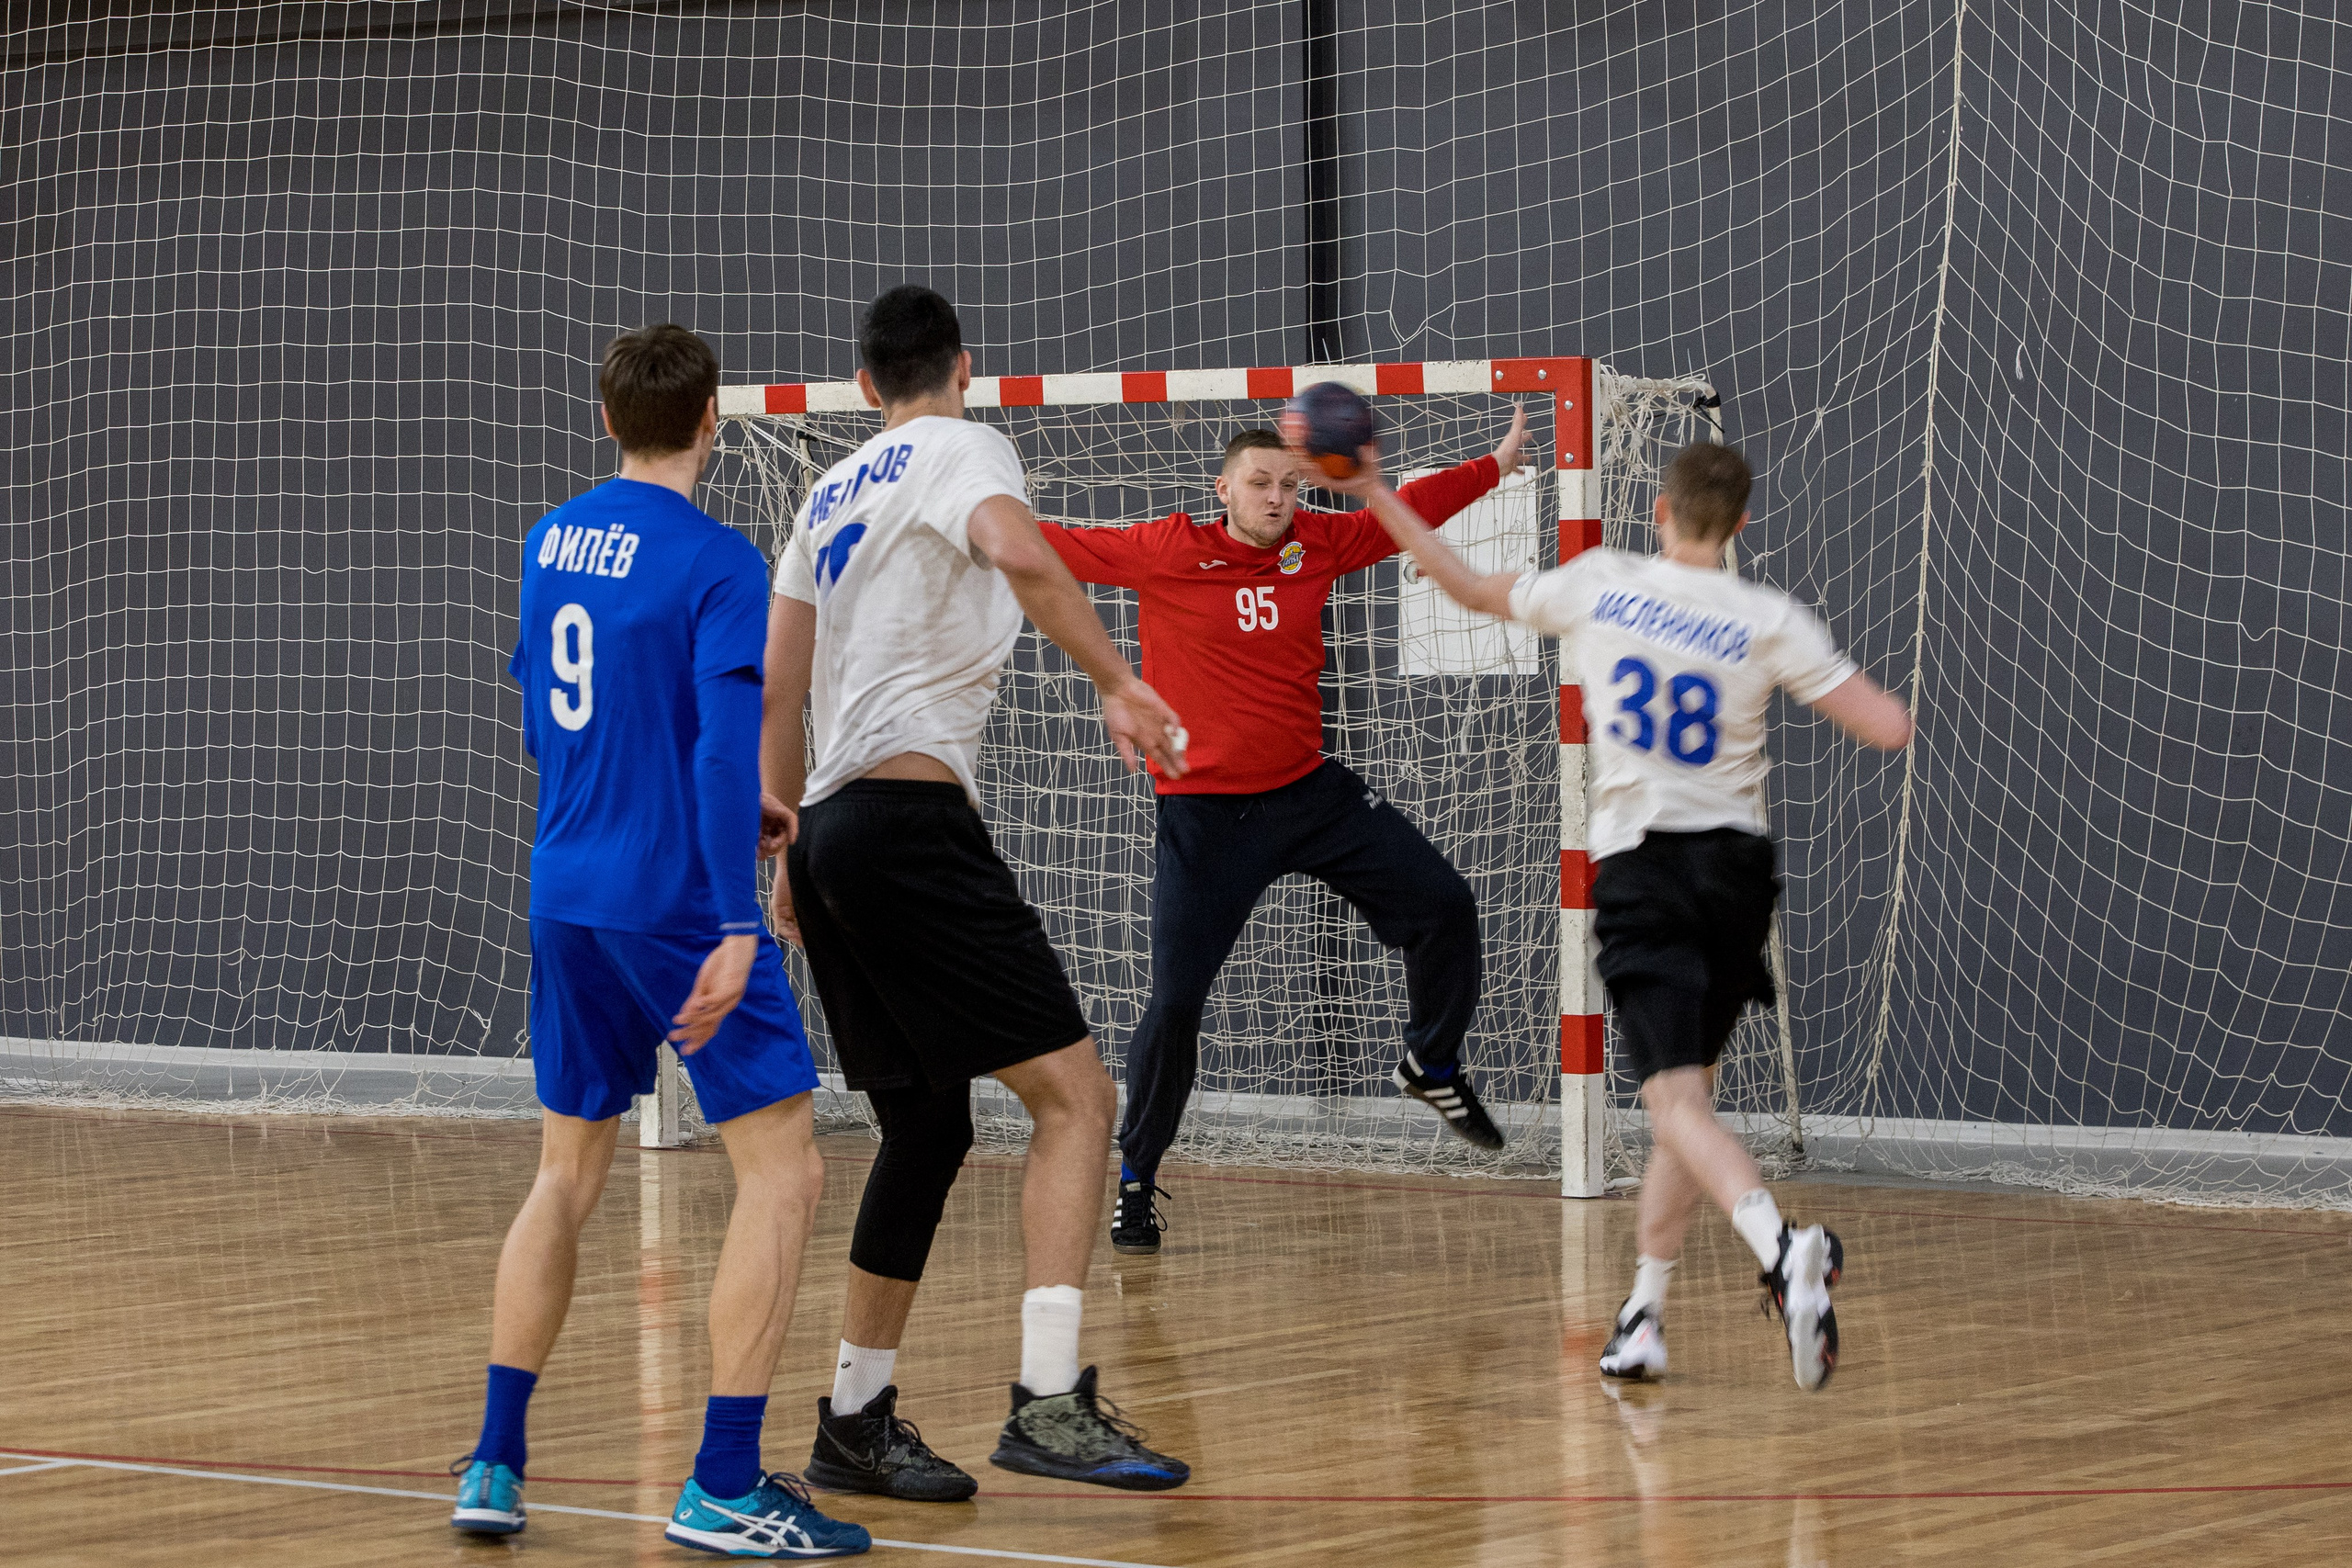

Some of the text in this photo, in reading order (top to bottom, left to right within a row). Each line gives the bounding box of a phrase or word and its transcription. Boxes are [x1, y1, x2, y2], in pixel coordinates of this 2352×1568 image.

[537, 523, 640, 579] ФИЛЁВ
[1236, 586, 1279, 632] 95
[550, 603, 594, 731] 9
[1611, 654, 1718, 769] 38
